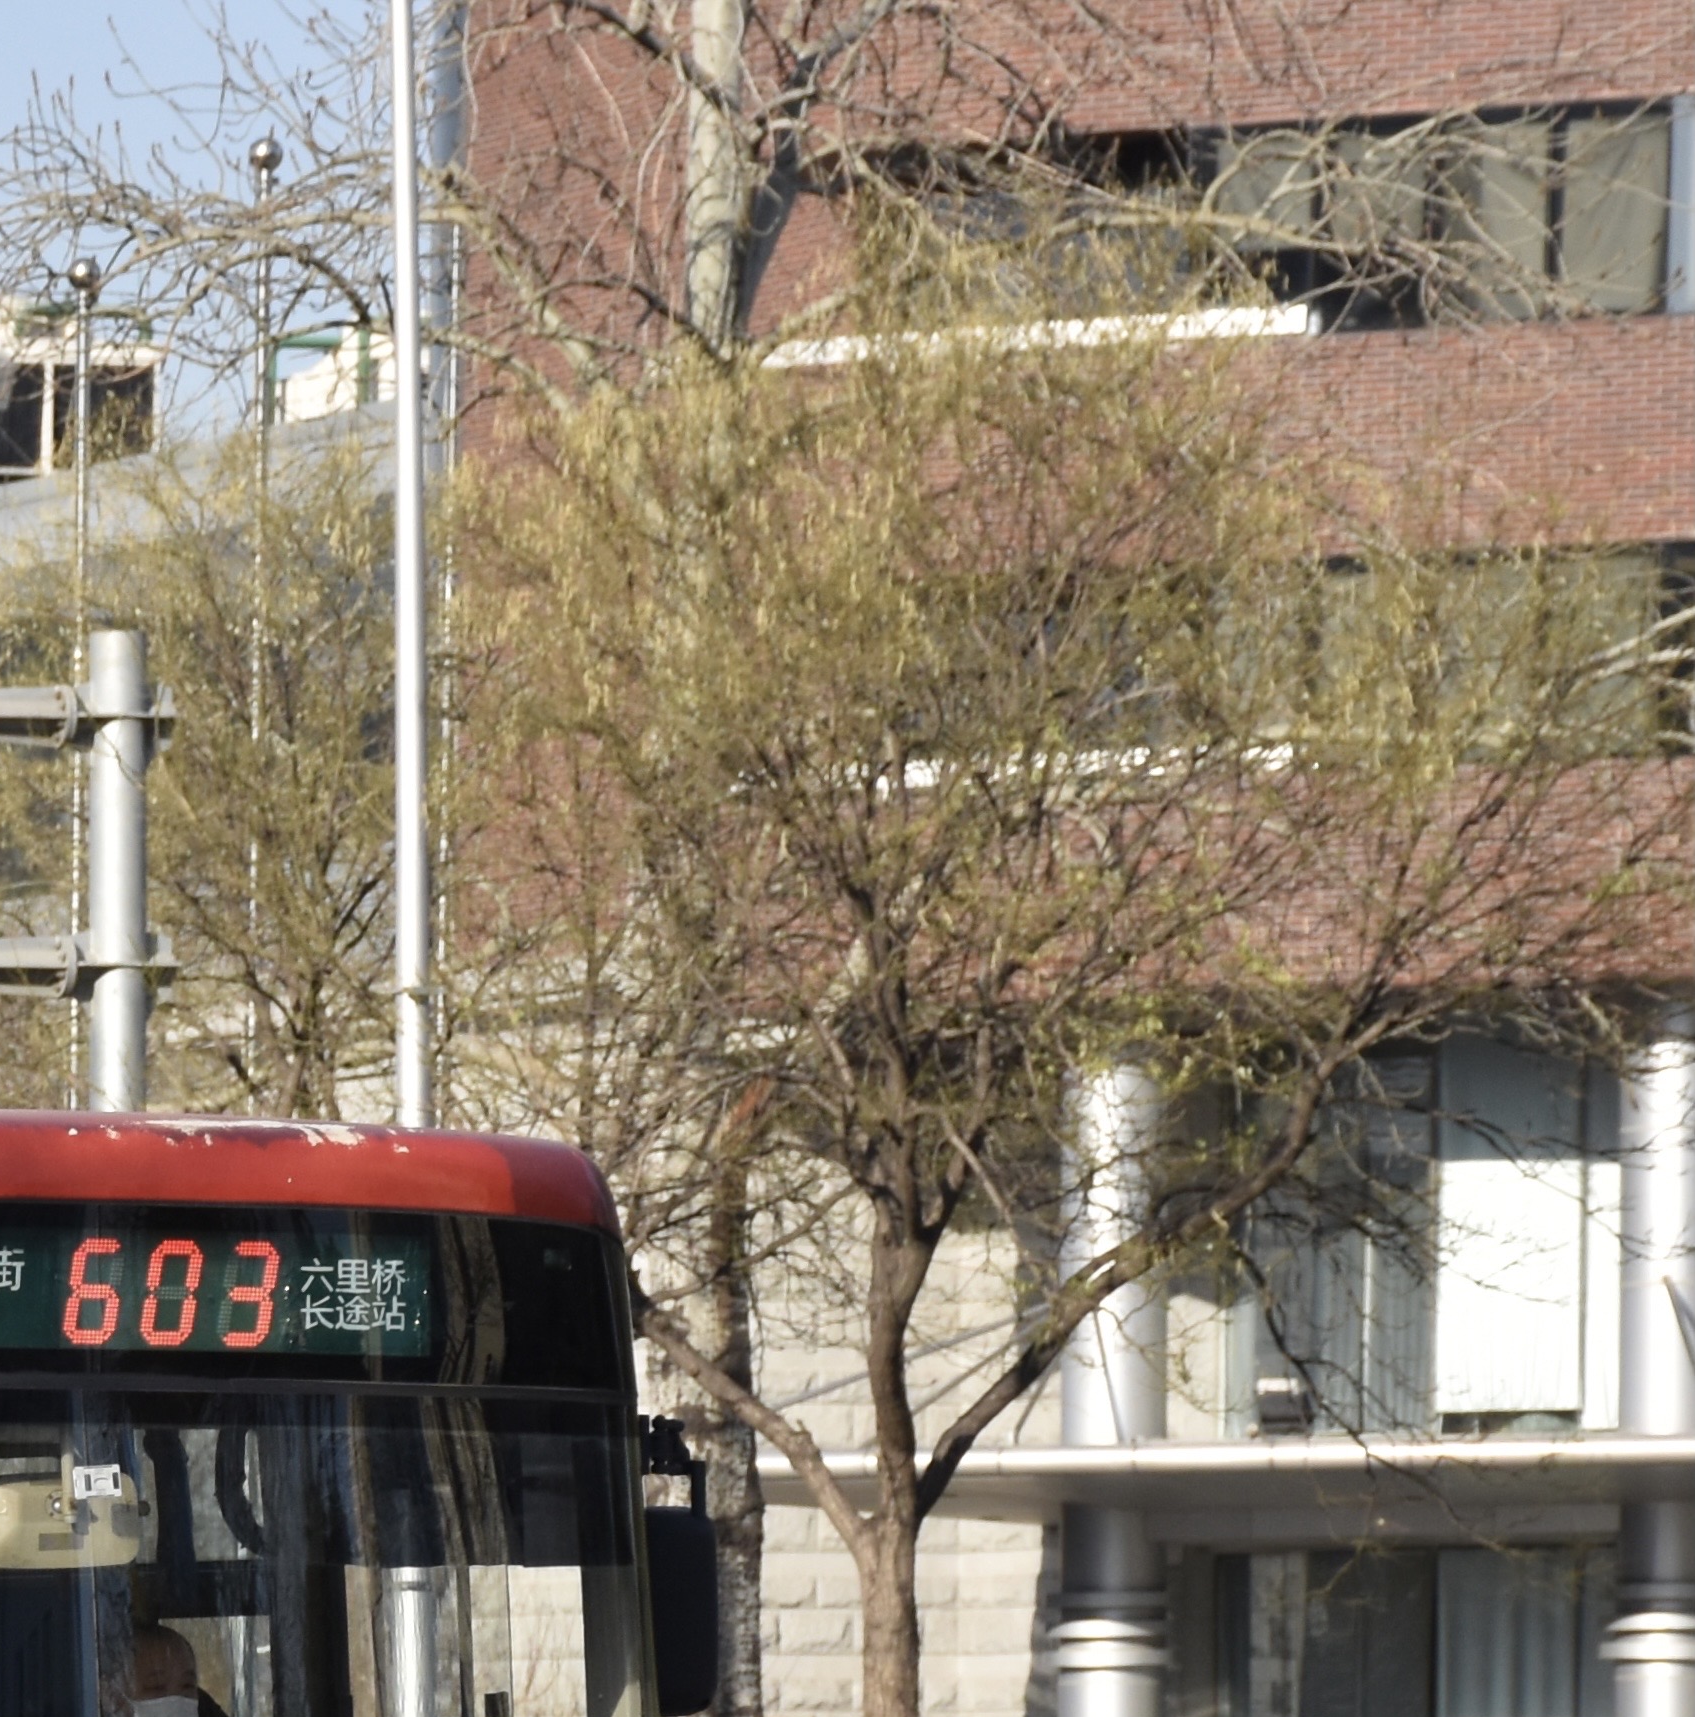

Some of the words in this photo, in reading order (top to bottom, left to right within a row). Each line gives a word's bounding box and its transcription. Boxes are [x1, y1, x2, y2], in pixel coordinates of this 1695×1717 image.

[61, 1237, 281, 1348] 603
[300, 1257, 407, 1296] 六里桥
[300, 1294, 407, 1331] 长途站
